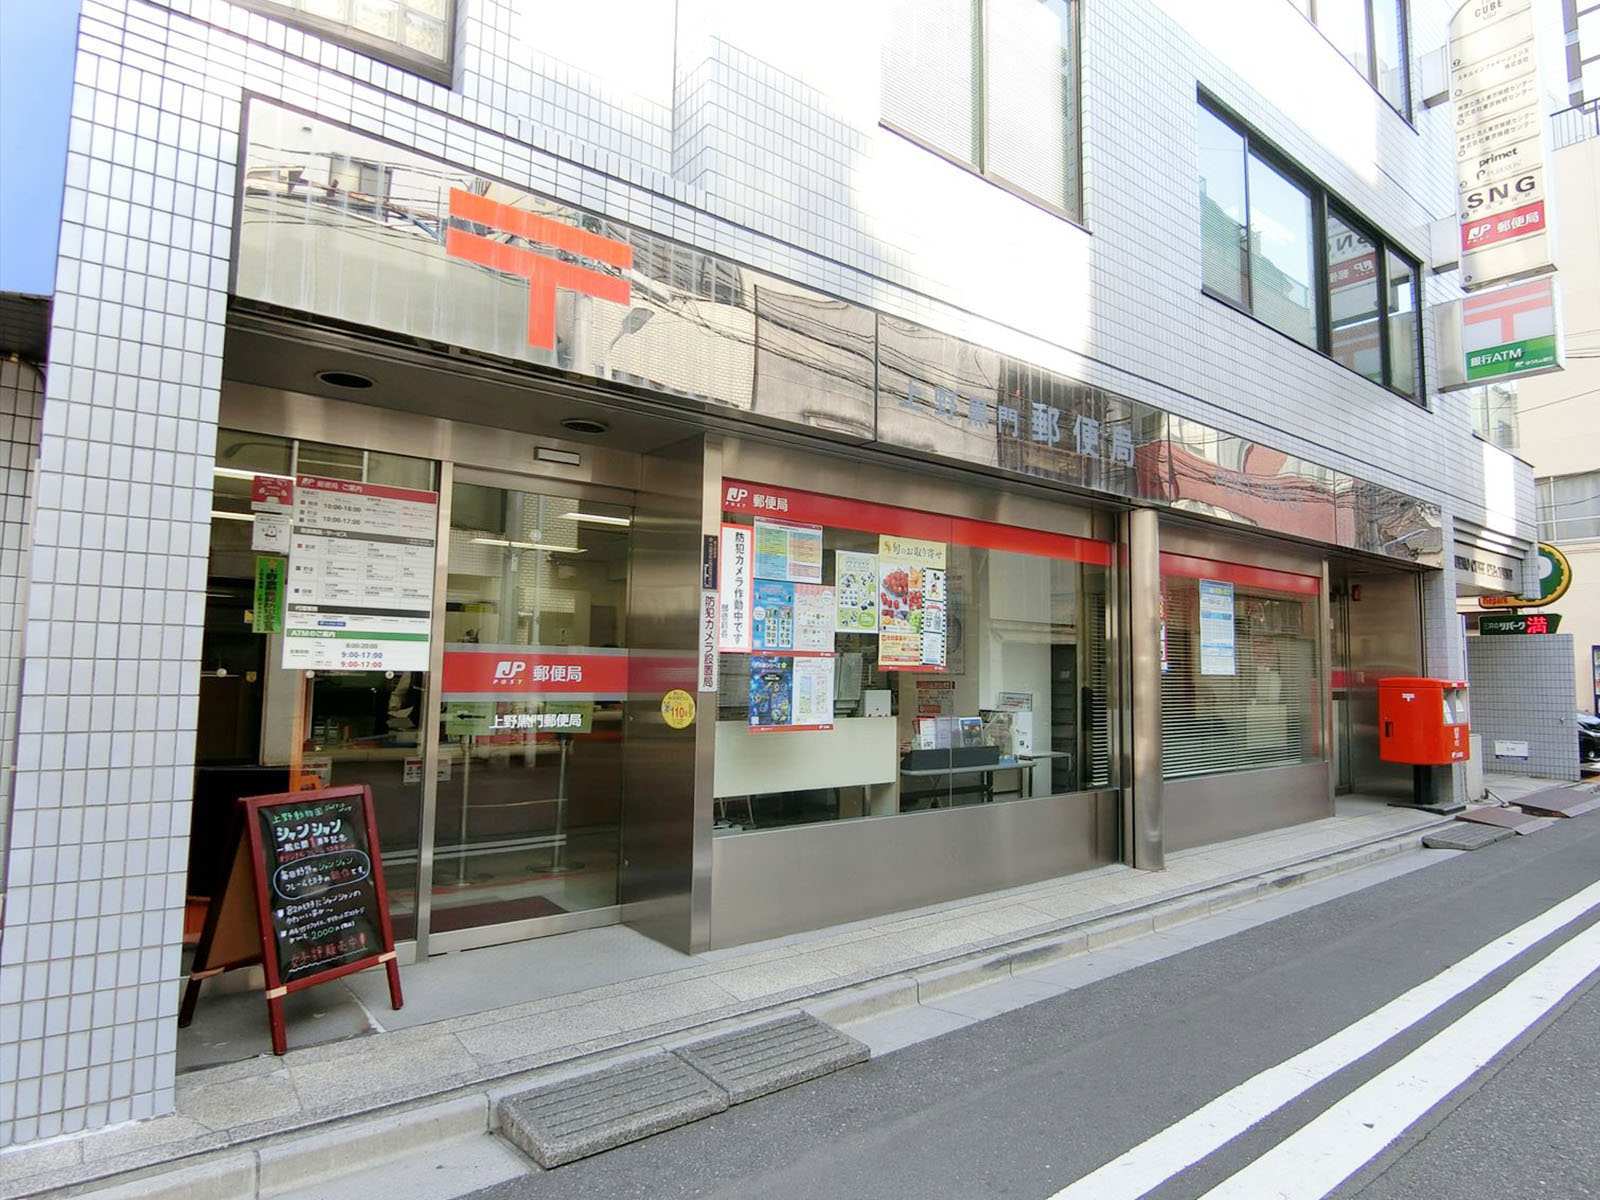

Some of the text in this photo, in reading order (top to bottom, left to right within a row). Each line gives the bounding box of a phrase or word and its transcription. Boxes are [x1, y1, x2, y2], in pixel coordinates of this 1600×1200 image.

[1467, 176, 1536, 209] SNG
[1496, 211, 1540, 233] 郵便局
[1470, 347, 1523, 368] 銀行ATM
[898, 379, 1135, 468] 上野黒門郵便局
[753, 494, 789, 512] 郵便局
[733, 531, 745, 645] 防犯カメラ作動中です
[1526, 616, 1548, 634] 満
[341, 651, 384, 659] 9:00-17:00
[533, 665, 583, 683] 郵便局
[489, 713, 582, 729] 上野黒門郵便局
[272, 807, 323, 824] 上野動物園
[276, 819, 341, 841] シャンシャン
